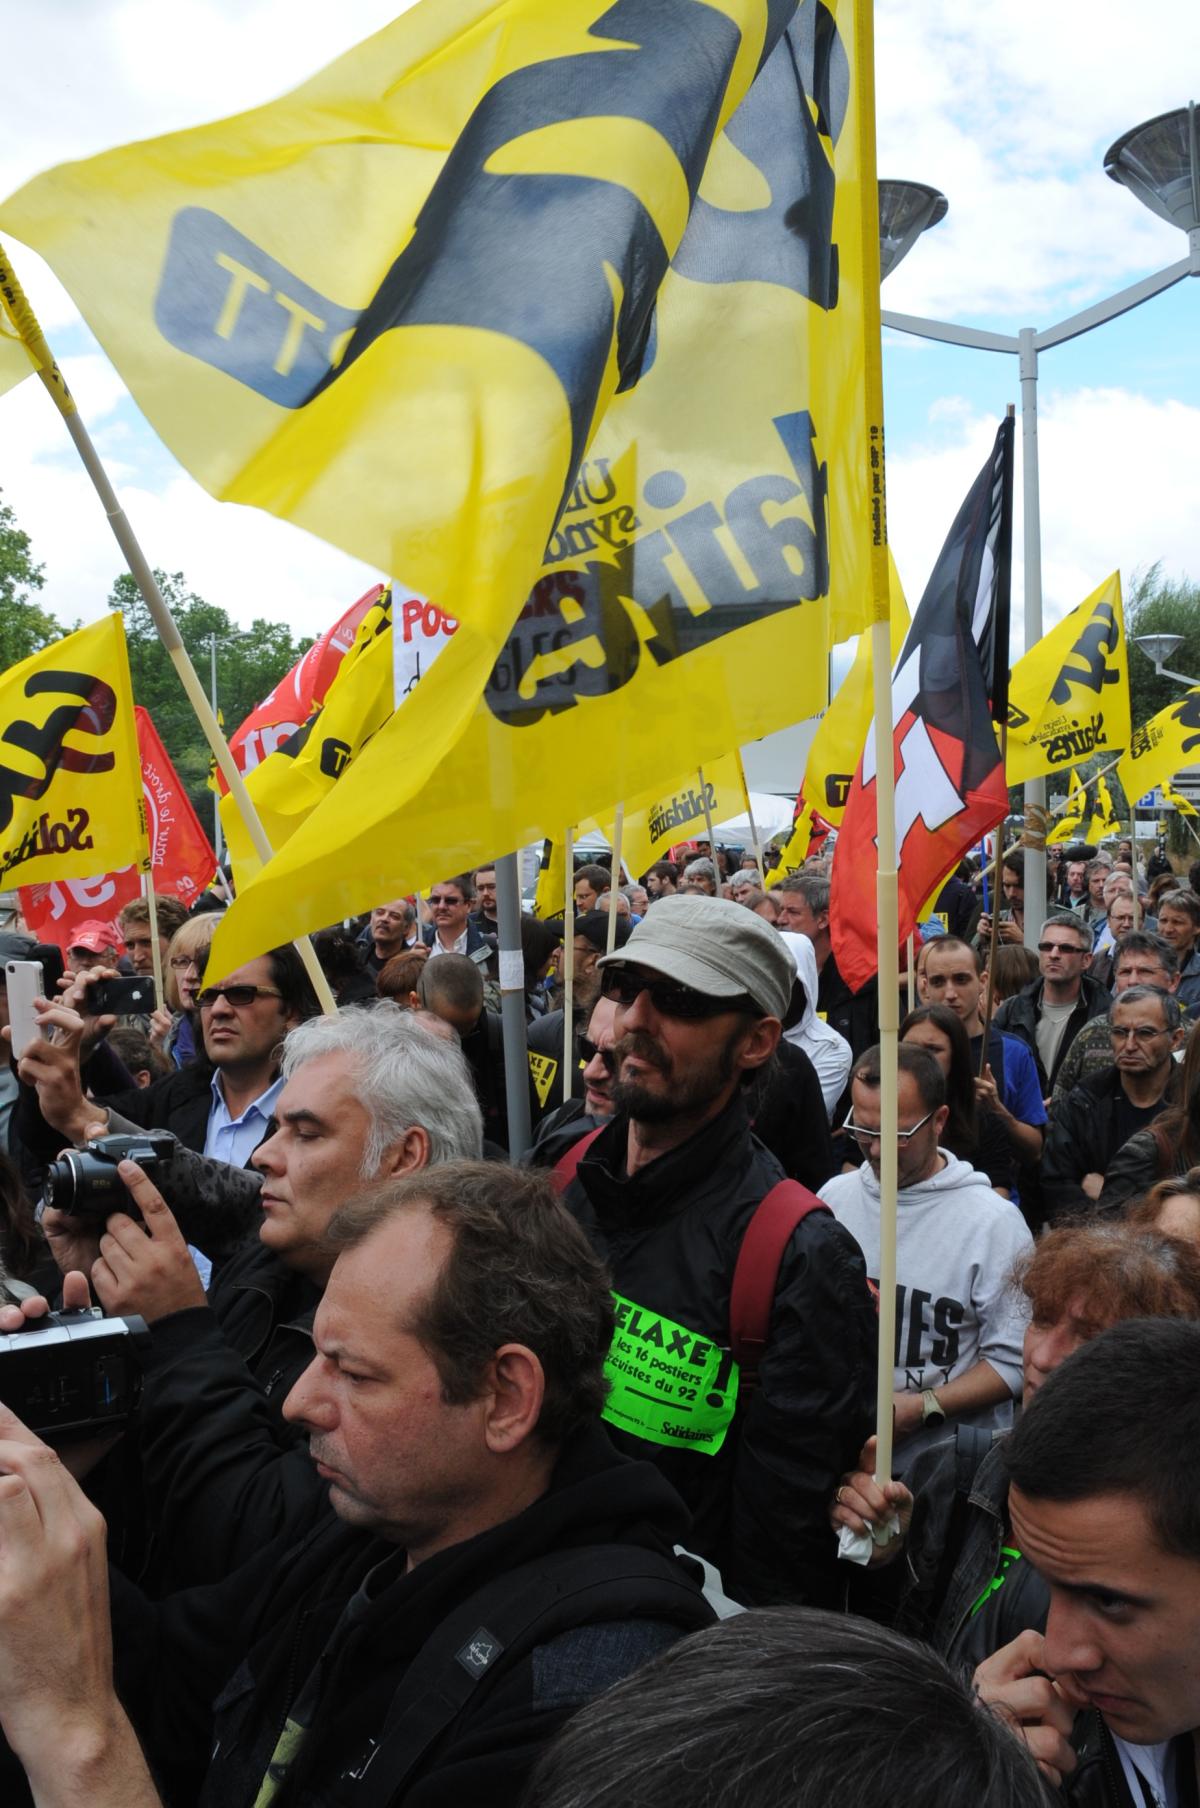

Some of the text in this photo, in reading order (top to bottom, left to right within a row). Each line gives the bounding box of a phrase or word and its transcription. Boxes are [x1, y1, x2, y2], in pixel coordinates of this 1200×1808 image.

[616, 1337, 704, 1386] les 16 postiers
[654, 1378, 674, 1394] du
[678, 1386, 698, 1402] 92
